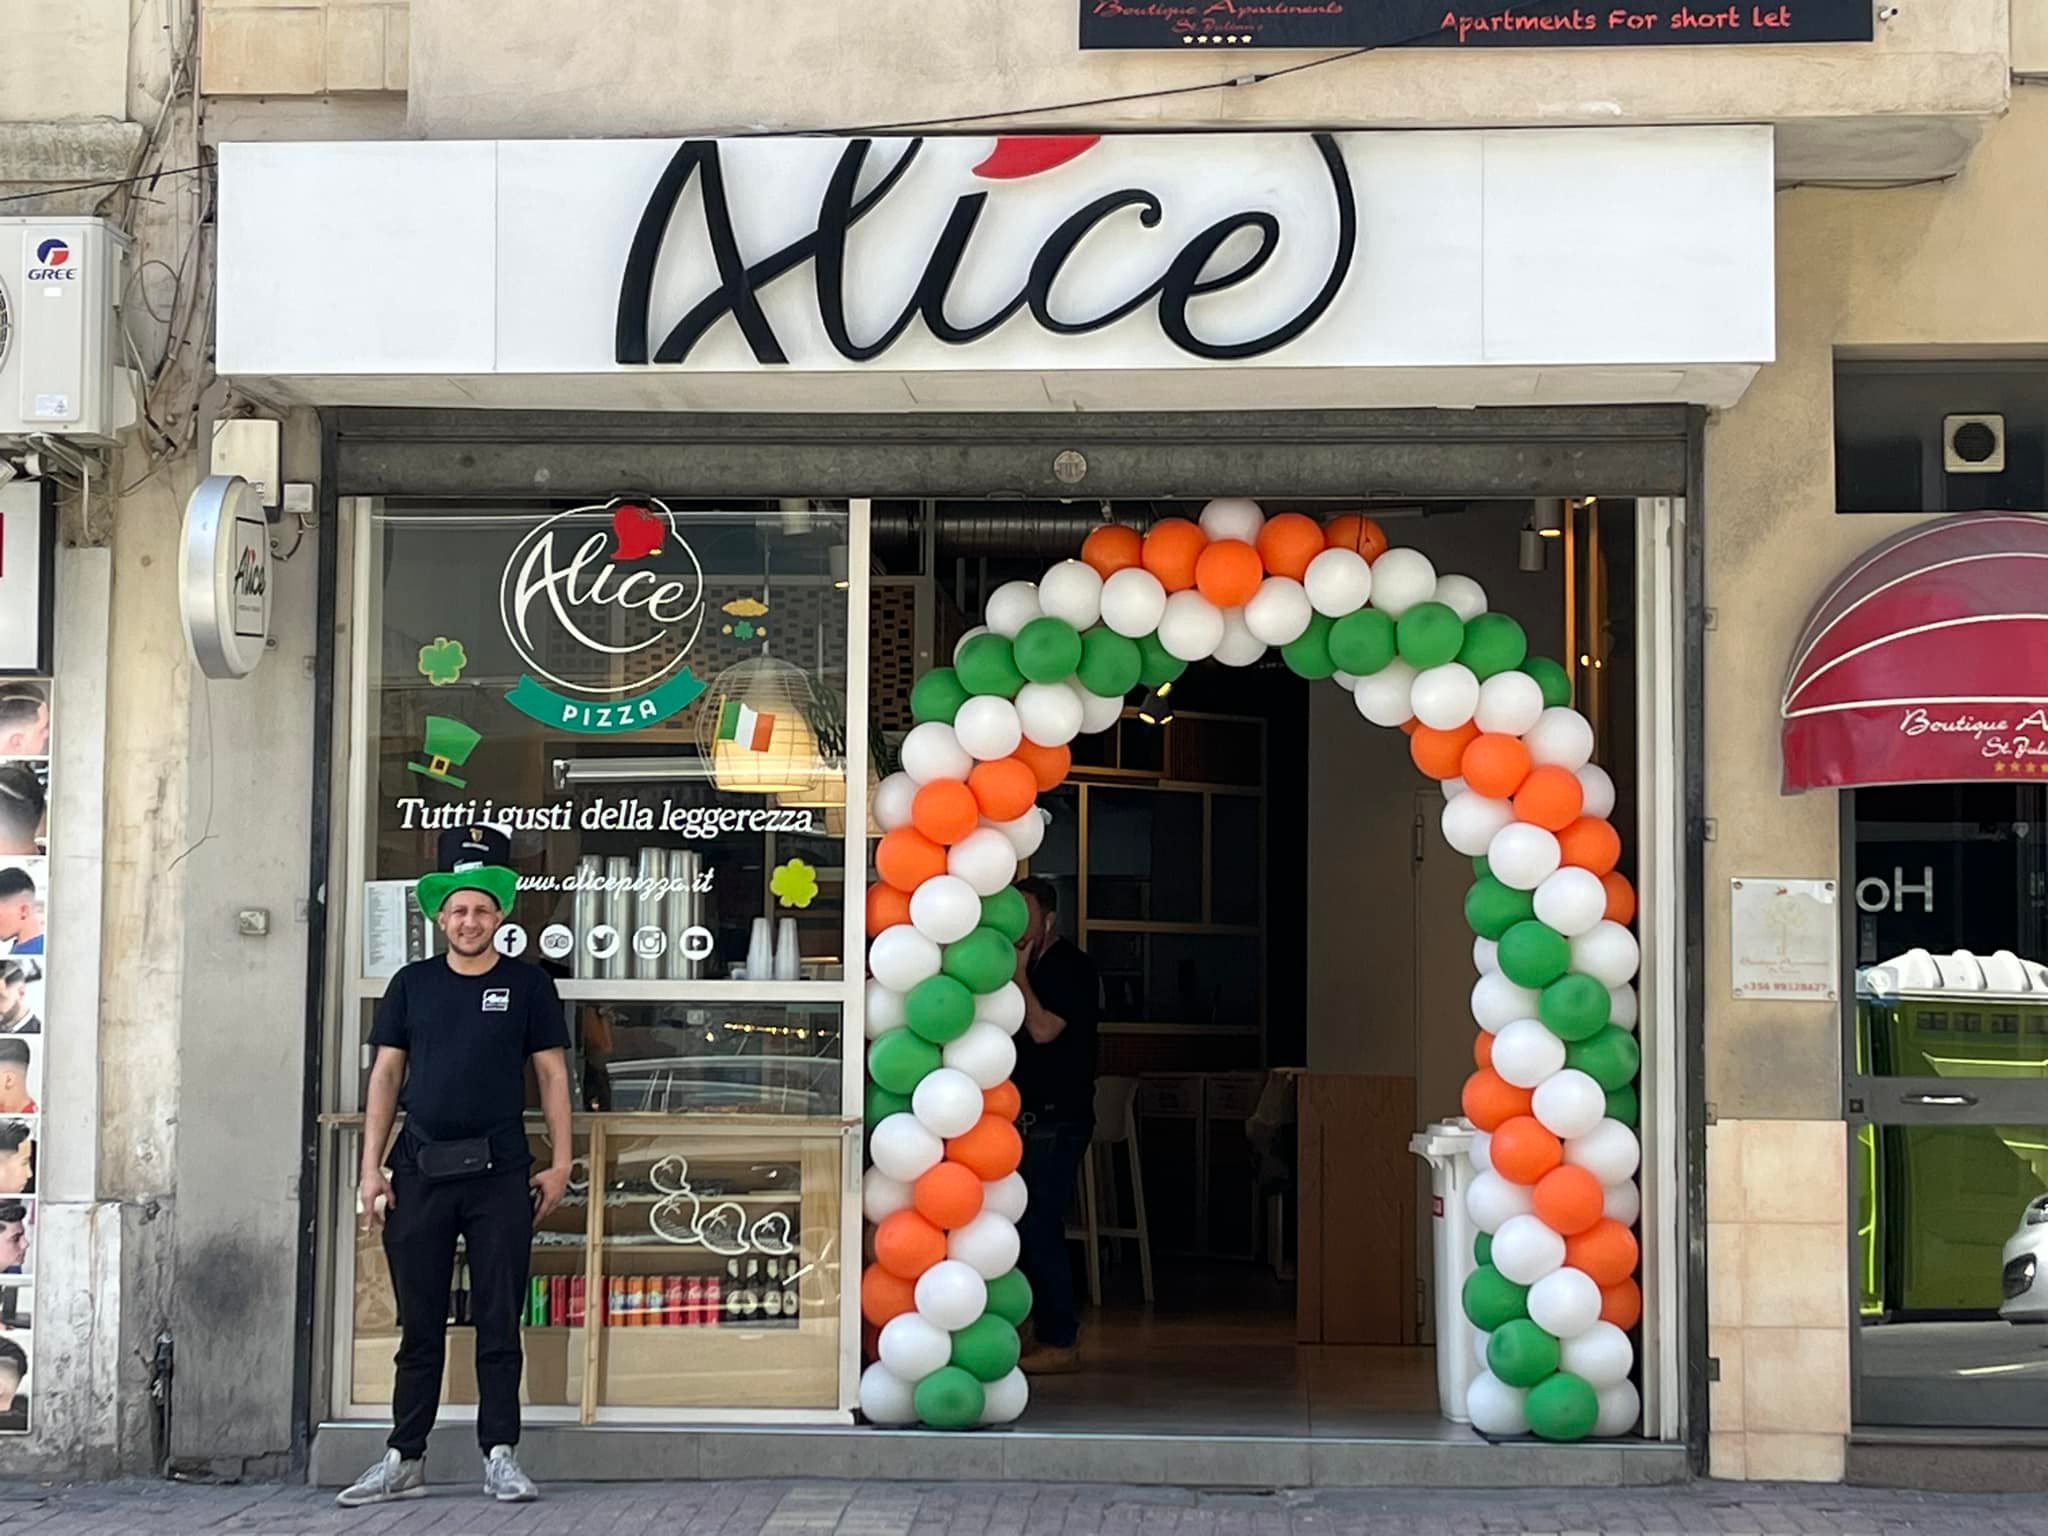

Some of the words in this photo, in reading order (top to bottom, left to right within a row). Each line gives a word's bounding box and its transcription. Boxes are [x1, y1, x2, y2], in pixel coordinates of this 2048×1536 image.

[1440, 9, 1597, 43] Apartments
[1608, 9, 1658, 30] For
[1670, 6, 1740, 30] short
[1753, 5, 1792, 28] let
[615, 134, 1356, 365] Alice
[28, 268, 78, 280] GREE
[514, 530, 700, 653] Alice
[562, 699, 657, 728] PIZZA
[1899, 708, 2008, 740] Boutique
[397, 798, 477, 830] Tutti
[498, 800, 573, 831] gusti
[580, 798, 654, 831] della
[658, 800, 813, 840] leggerezza
